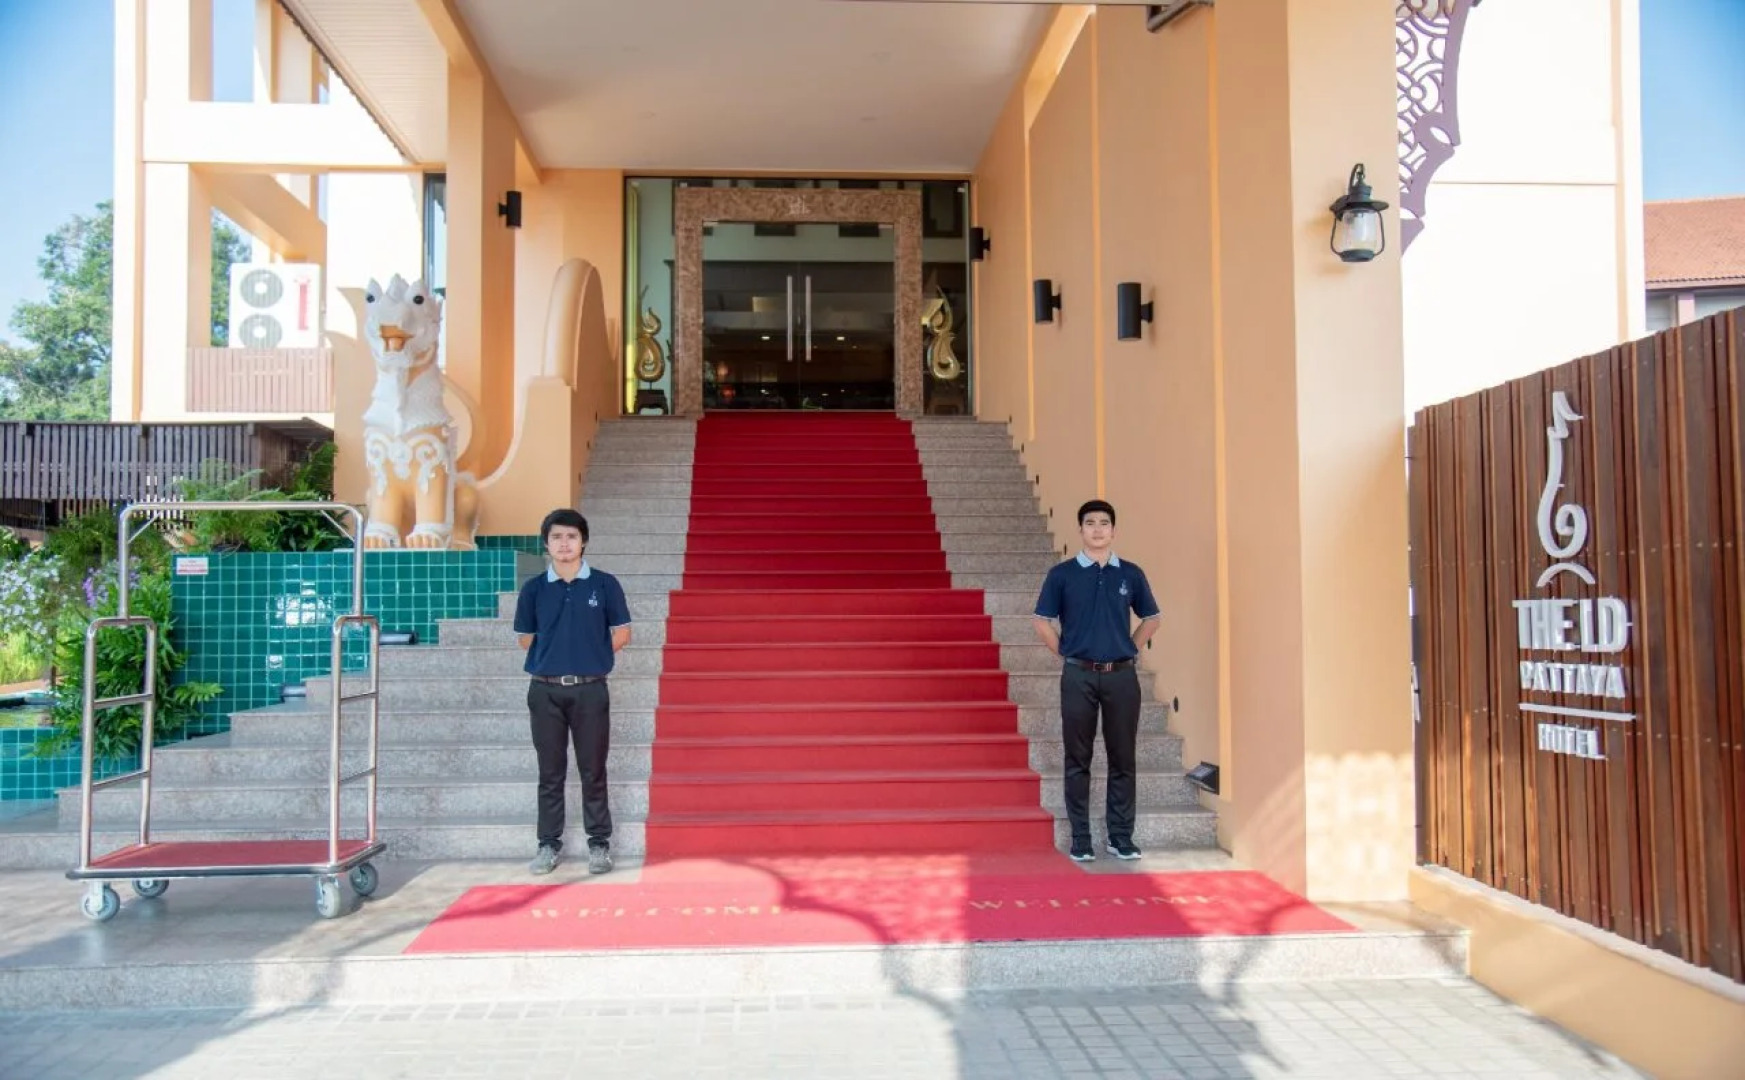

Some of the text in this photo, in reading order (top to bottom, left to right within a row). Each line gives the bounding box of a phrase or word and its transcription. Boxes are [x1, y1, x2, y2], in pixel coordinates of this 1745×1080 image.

[1579, 596, 1630, 654] LD
[1519, 660, 1627, 699] PATTAYA
[1537, 723, 1608, 760] HOTEL
[526, 903, 795, 919] WELCOME
[968, 894, 1219, 910] WELCOME
